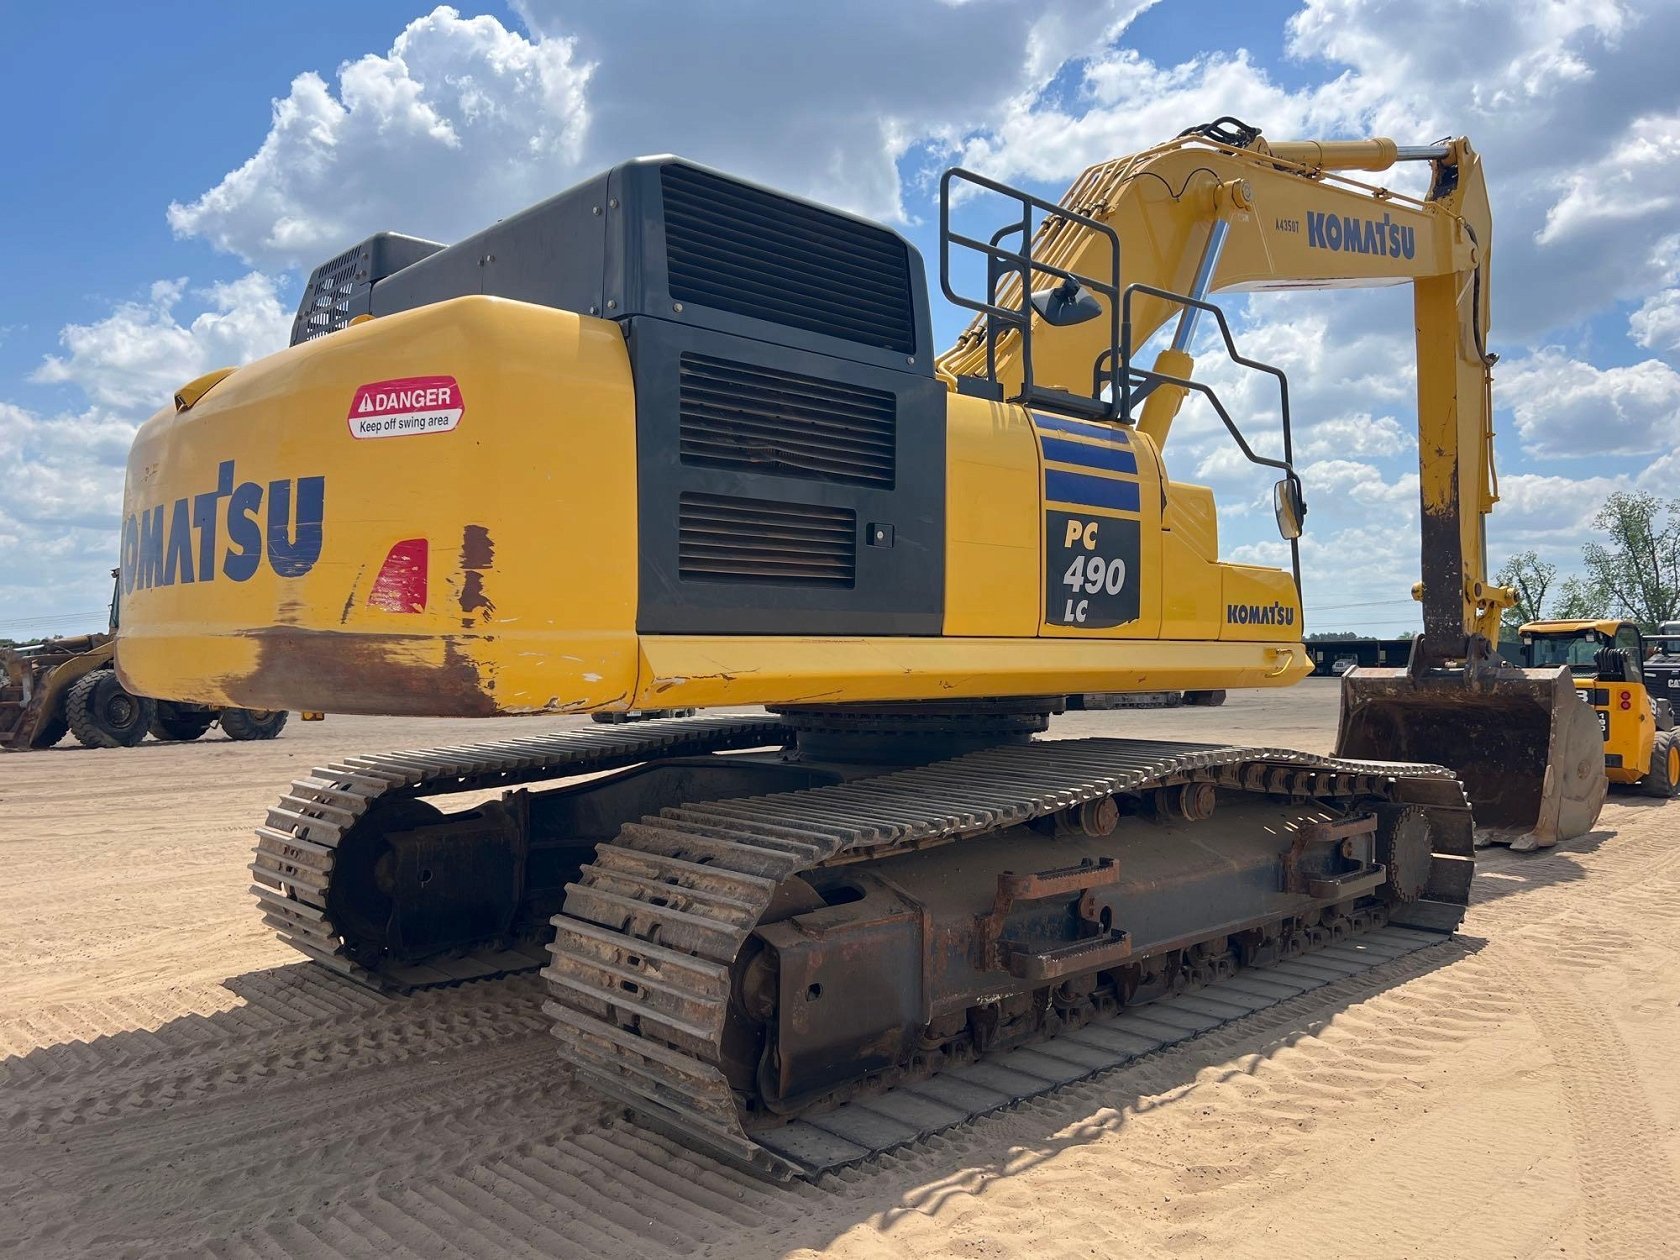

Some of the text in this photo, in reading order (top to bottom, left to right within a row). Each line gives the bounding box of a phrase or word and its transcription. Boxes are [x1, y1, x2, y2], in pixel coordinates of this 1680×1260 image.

[1306, 211, 1415, 260] KOMATSU
[375, 388, 451, 411] DANGER
[360, 416, 449, 434] Keep off swing area
[119, 459, 325, 596] OMATSU
[1064, 519, 1099, 550] PC
[1063, 555, 1126, 596] 490
[1063, 599, 1089, 623] LC
[1227, 601, 1294, 626] KOMATSU
[1667, 679, 1680, 688] CA
